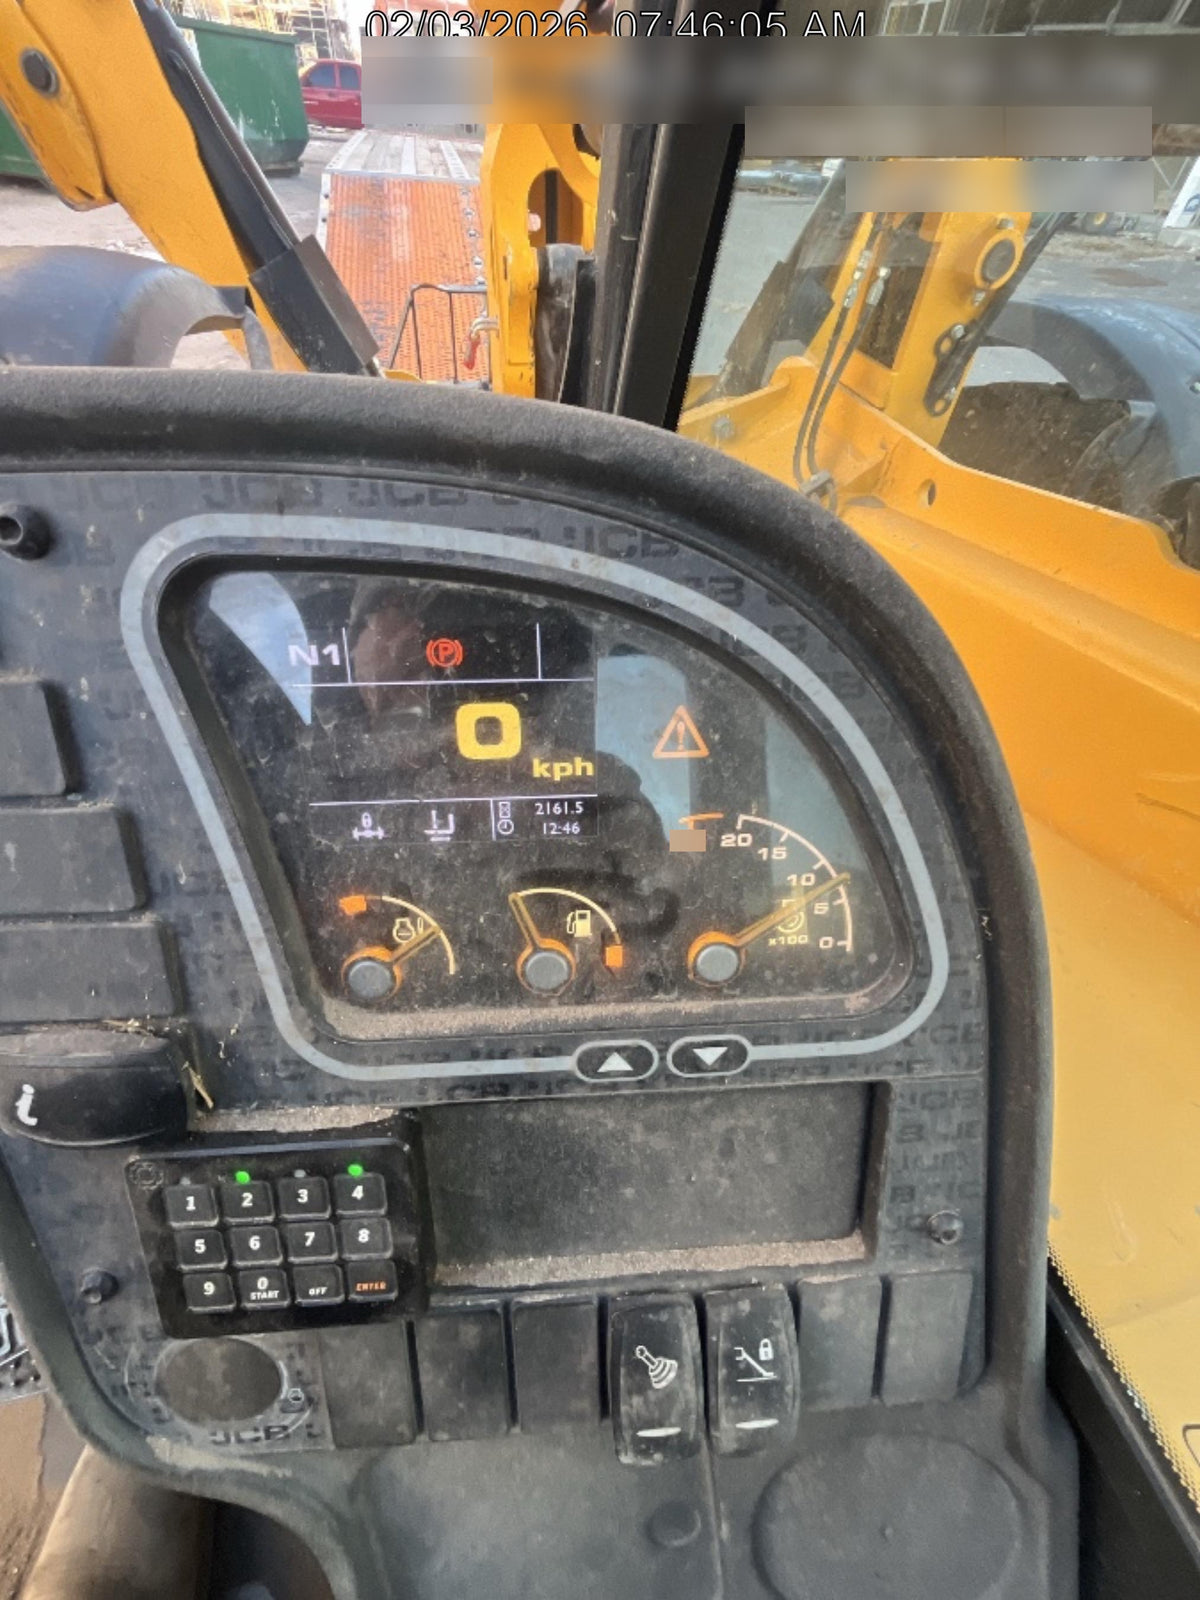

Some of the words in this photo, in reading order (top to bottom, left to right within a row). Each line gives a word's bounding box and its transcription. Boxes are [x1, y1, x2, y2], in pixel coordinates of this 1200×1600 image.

[288, 643, 341, 666] N1
[455, 702, 522, 760] 0
[532, 757, 595, 781] kph
[534, 801, 584, 815] 2161.5
[720, 833, 753, 848] 20
[757, 847, 787, 861] 15
[787, 873, 816, 886] 10
[813, 903, 829, 915] 5
[818, 936, 833, 949] 0
[297, 1189, 309, 1204] 3
[351, 1185, 364, 1200] 4
[186, 1196, 196, 1211] 1
[241, 1193, 253, 1207] 2
[304, 1232, 315, 1246] 7
[358, 1228, 370, 1242] 8
[194, 1239, 206, 1253] 5
[249, 1235, 260, 1250] 6
[203, 1281, 215, 1295] 9
[257, 1277, 269, 1290] 0
[356, 1281, 386, 1292] ENTER
[250, 1290, 280, 1300] START
[309, 1286, 328, 1296] OFF
